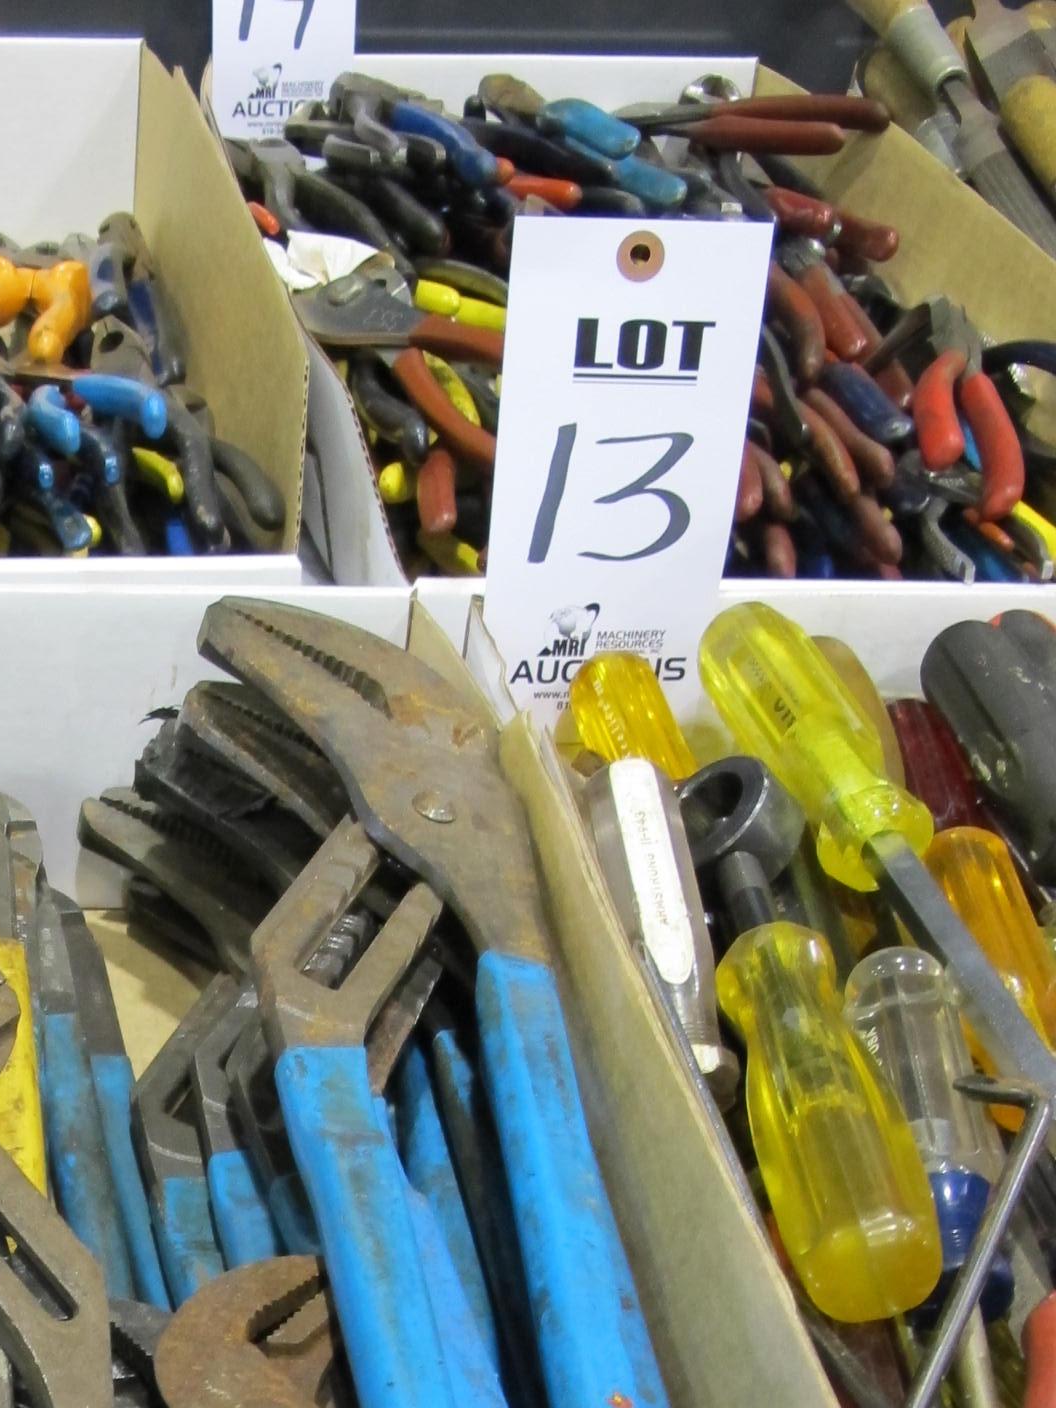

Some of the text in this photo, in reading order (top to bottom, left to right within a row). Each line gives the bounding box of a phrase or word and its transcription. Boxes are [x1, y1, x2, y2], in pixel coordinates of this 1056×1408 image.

[232, 99, 306, 118] AUCTI
[573, 318, 716, 371] LOT
[527, 422, 694, 564] 13
[595, 639, 663, 649] RESOURCES
[597, 629, 666, 640] MACHINERY
[552, 638, 587, 657] MRI
